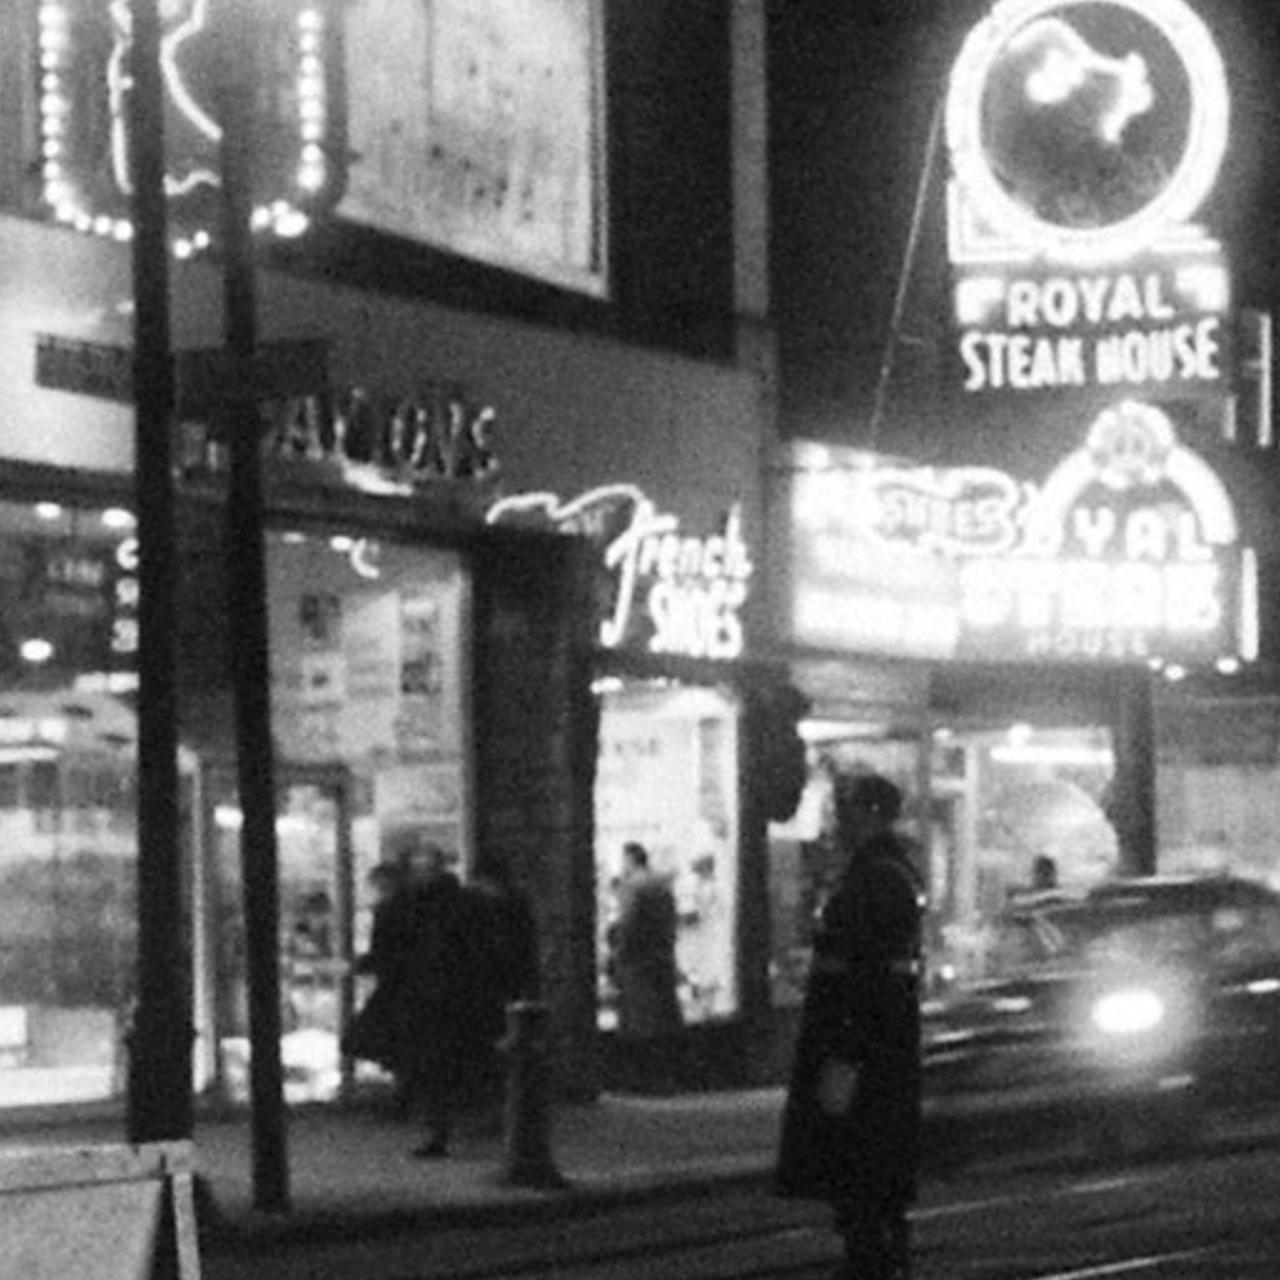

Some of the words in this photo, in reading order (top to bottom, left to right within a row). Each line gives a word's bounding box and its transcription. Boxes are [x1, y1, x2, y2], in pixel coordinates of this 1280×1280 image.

[1007, 273, 1174, 326] ROYAL
[960, 331, 1085, 391] STEAK
[1095, 317, 1219, 384] HOUSE
